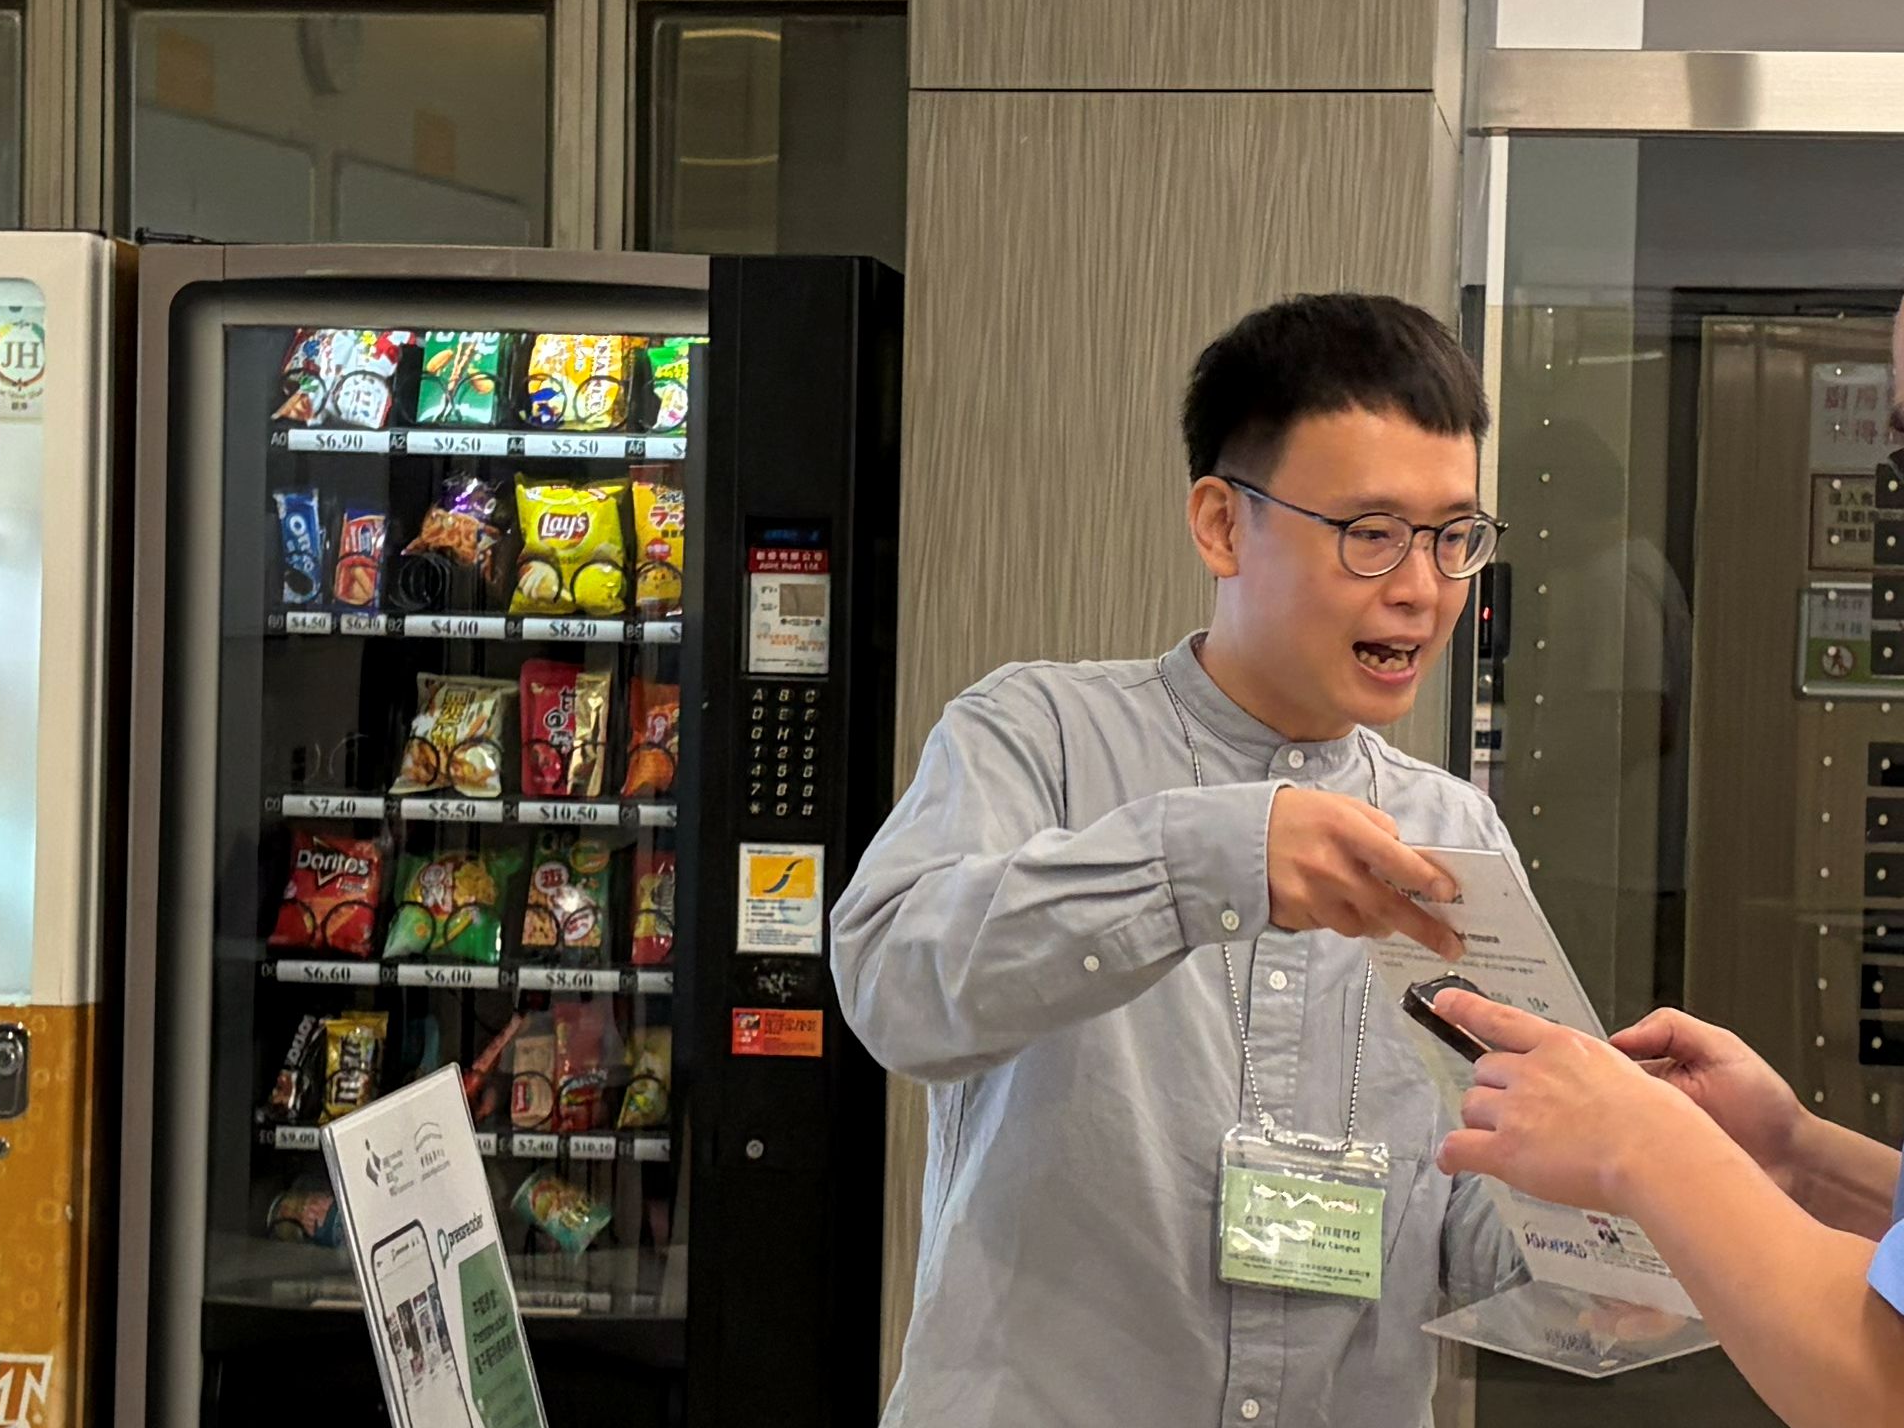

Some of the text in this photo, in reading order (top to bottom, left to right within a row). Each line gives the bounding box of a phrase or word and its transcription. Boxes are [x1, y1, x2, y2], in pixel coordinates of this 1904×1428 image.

[1, 341, 40, 368] JH
[316, 433, 364, 450] $6.90
[433, 437, 482, 452] $9.50
[552, 439, 599, 455] $5.50
[541, 511, 588, 540] Lay's
[431, 619, 479, 637] $4.00
[549, 622, 597, 638] $8.20
[309, 799, 356, 814] $7.40
[428, 803, 476, 819] $5.50
[539, 805, 597, 822] $10.50
[297, 849, 369, 876] Doritos
[304, 966, 351, 982] $6.60
[424, 969, 472, 985] $6.00
